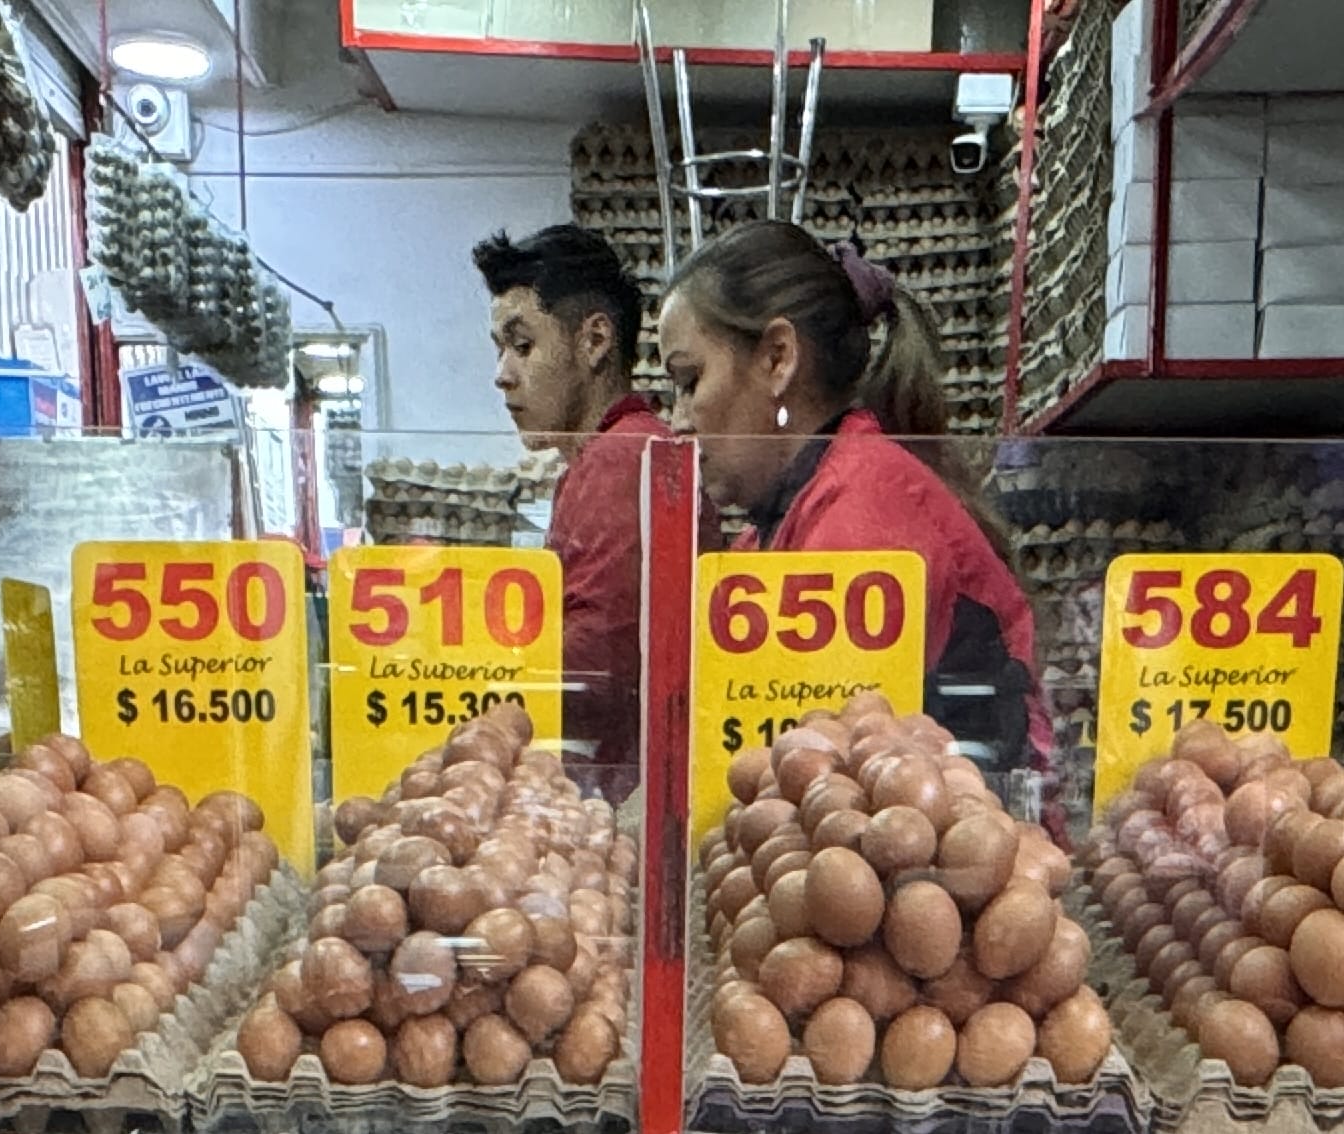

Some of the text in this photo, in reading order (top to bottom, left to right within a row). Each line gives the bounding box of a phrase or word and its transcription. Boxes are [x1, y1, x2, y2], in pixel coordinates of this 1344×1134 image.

[91, 561, 286, 642] 550
[349, 568, 544, 647] 510
[708, 572, 906, 654] 650
[1122, 569, 1322, 649] 584
[118, 653, 273, 680] La Superior
[369, 657, 402, 679] La
[1140, 664, 1298, 692] La Superior
[117, 689, 276, 726] $ 16.500
[726, 679, 758, 702] La
[366, 692, 387, 728] $
[1129, 699, 1292, 737] $ 17500
[722, 718, 743, 752] $
